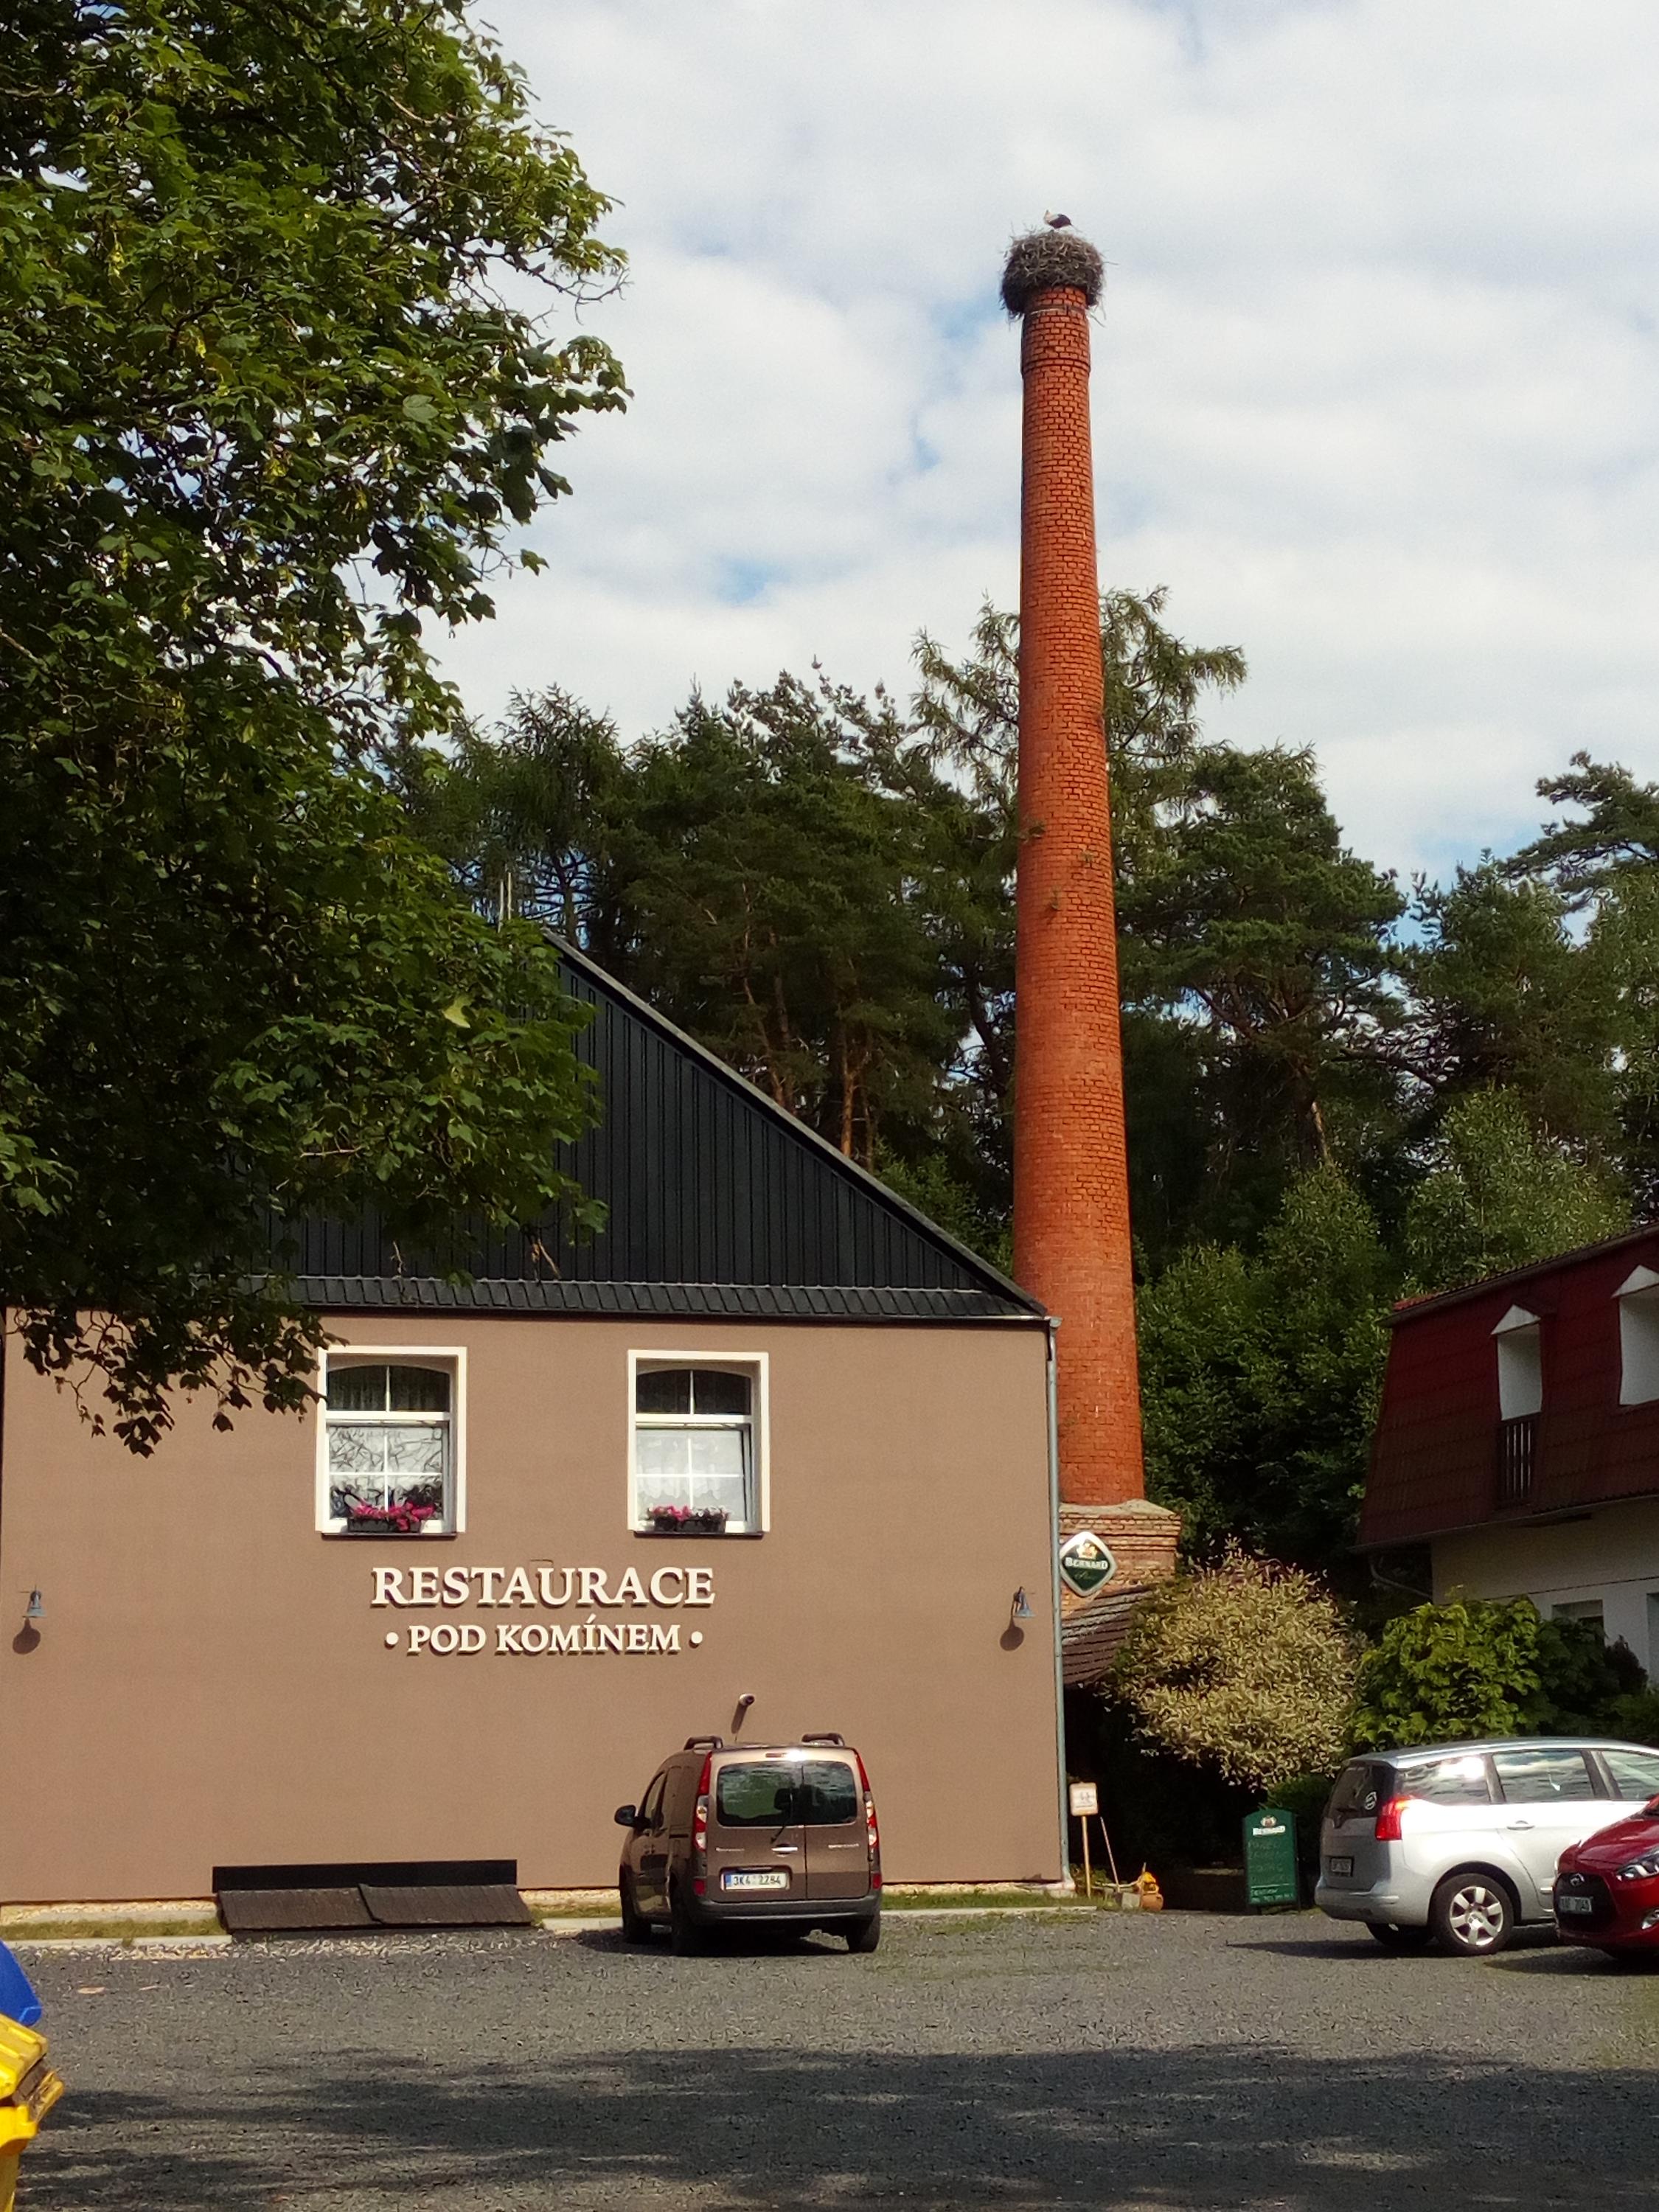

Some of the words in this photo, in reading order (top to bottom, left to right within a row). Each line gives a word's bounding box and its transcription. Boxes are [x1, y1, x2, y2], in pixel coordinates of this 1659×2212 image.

[371, 1566, 715, 1606] RESTAURACE
[408, 1624, 487, 1654] POD
[496, 1614, 681, 1654] KOMÍNEM
